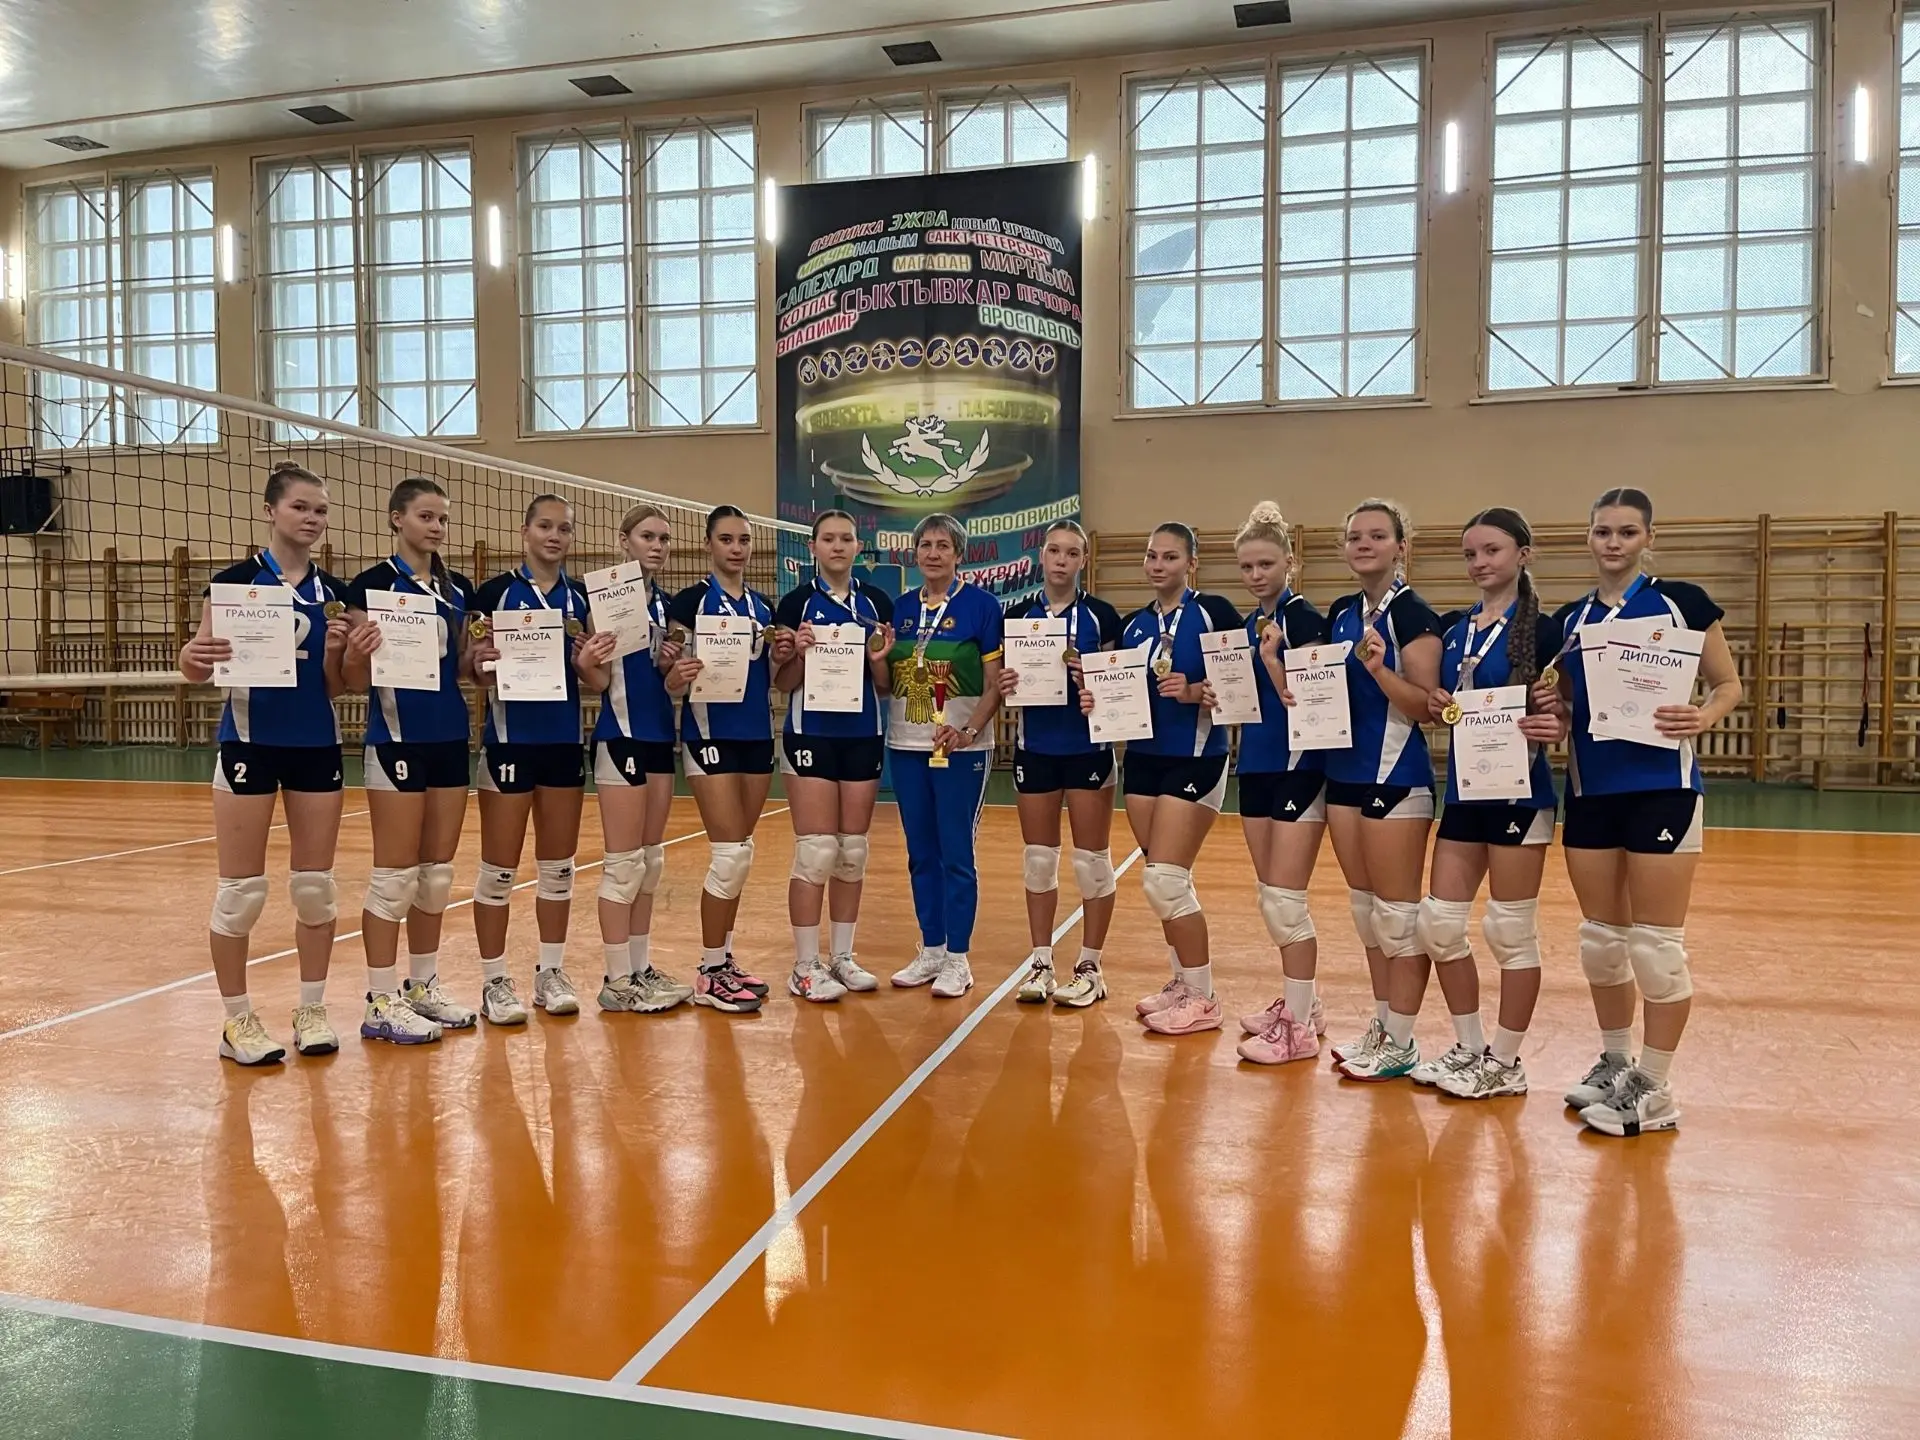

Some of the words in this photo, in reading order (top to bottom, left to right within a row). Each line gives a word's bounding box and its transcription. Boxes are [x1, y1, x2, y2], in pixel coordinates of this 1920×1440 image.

[888, 209, 948, 231] ЭЖВА
[852, 233, 919, 257] НАДЫМ
[951, 217, 1000, 233] НОВЫЙ
[1003, 220, 1065, 255] УРЕНГОЙ
[927, 231, 1051, 264] САНКТ-ПЕТЕРБУРГ
[895, 254, 970, 271] МАГАДАН
[980, 249, 1075, 296] МИРНЫЙ
[776, 257, 879, 315] САЛЕХАРД
[840, 277, 1010, 316] СЫКТЫВКАР
[1016, 283, 1082, 322] ПЕЧОРА
[781, 291, 837, 332] КОТЛАС
[776, 313, 858, 357] ВЛАДИМИР
[981, 306, 1080, 347] ЯРОСЛАВЛЬ
[968, 496, 1079, 535] НОВОДВИНСК
[598, 586, 635, 602] ГРАМОТА
[226, 609, 280, 619] ГРАМОТА
[380, 612, 426, 625] ГРАМОТА
[505, 631, 551, 642] ГРАМОТА
[706, 637, 741, 646] ГРАМОТА
[1015, 639, 1056, 648] ГРАМОТА
[816, 645, 854, 655] ГРАМОТА
[1212, 653, 1243, 663] ГРАМОТА
[1620, 650, 1682, 668] ДИПЛОМ
[1094, 671, 1135, 682] ГРАМОТА
[1296, 669, 1336, 681] ГРАМОТА
[1465, 713, 1513, 726] ГРАМОТА
[700, 746, 720, 764] 10
[795, 749, 813, 767] 13
[234, 762, 247, 783] 2
[396, 760, 408, 780] 9
[499, 763, 515, 782] 11
[625, 757, 636, 775] 4
[1017, 765, 1024, 783] 5
